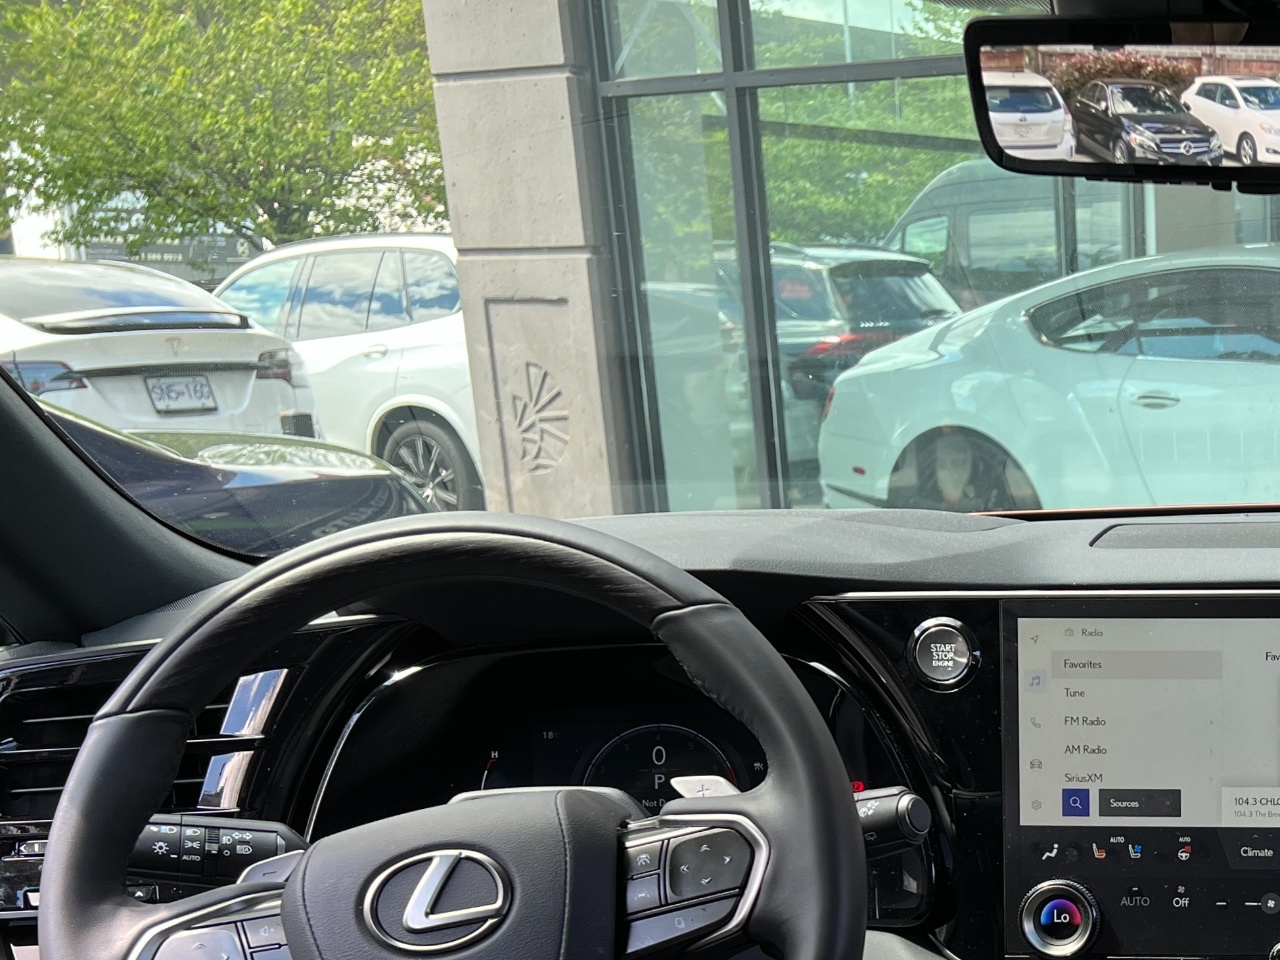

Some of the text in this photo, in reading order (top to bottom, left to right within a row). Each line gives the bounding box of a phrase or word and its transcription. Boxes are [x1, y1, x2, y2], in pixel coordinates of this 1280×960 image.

[1081, 628, 1103, 637] Radio
[930, 643, 956, 652] START
[932, 651, 954, 660] STOP
[1063, 659, 1102, 669] Favorites
[1064, 688, 1085, 698] Tune
[1064, 716, 1106, 726] FM Radio
[1064, 745, 1107, 755] AM Radio
[654, 774, 665, 790] P
[1064, 773, 1103, 783] SiriusXM
[642, 799, 658, 807] Not
[1110, 799, 1139, 808] Sources
[1234, 797, 1257, 806] 104.3
[1241, 847, 1273, 857] Climate
[1120, 897, 1150, 906] AUTO
[1173, 897, 1189, 907] Off
[1054, 909, 1069, 922] Lo
